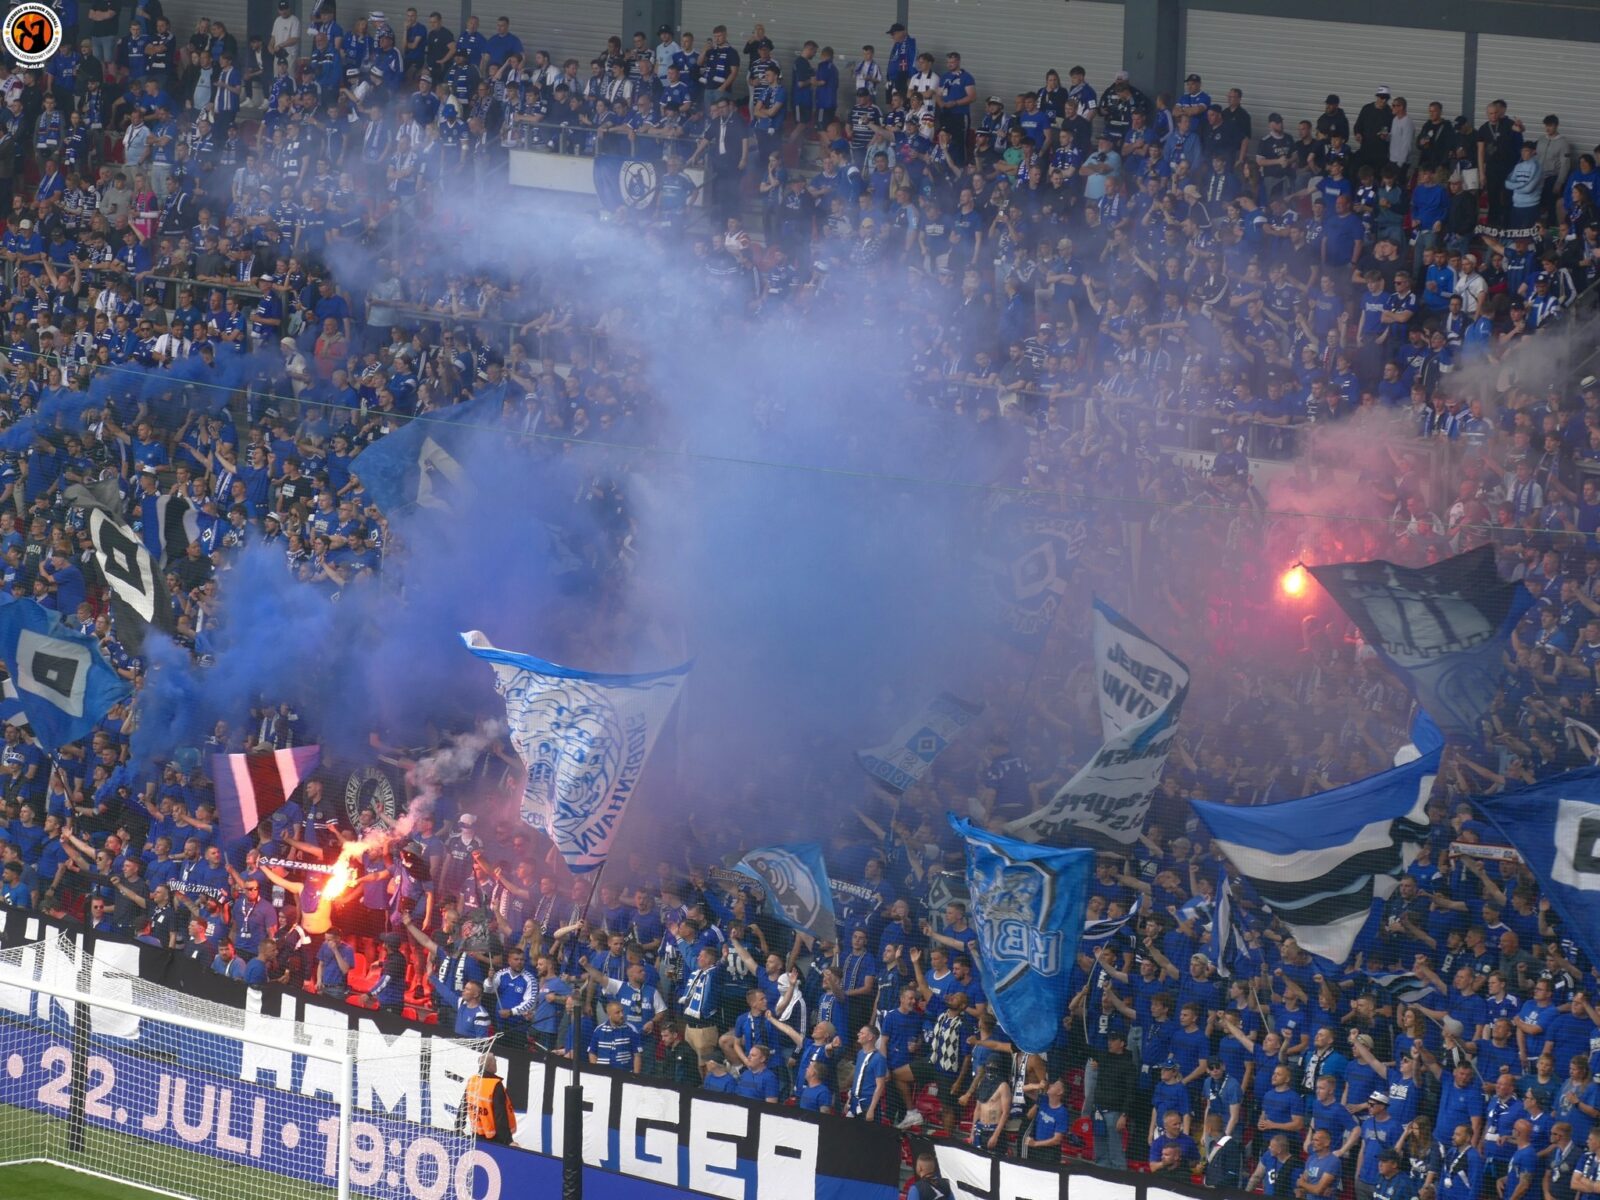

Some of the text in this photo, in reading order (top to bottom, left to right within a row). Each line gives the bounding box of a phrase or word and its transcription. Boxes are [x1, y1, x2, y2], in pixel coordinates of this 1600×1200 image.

[1107, 643, 1173, 699] JEDER
[269, 858, 335, 873] CASTAWAY
[37, 1045, 502, 1200] 22. JULI 19:00
